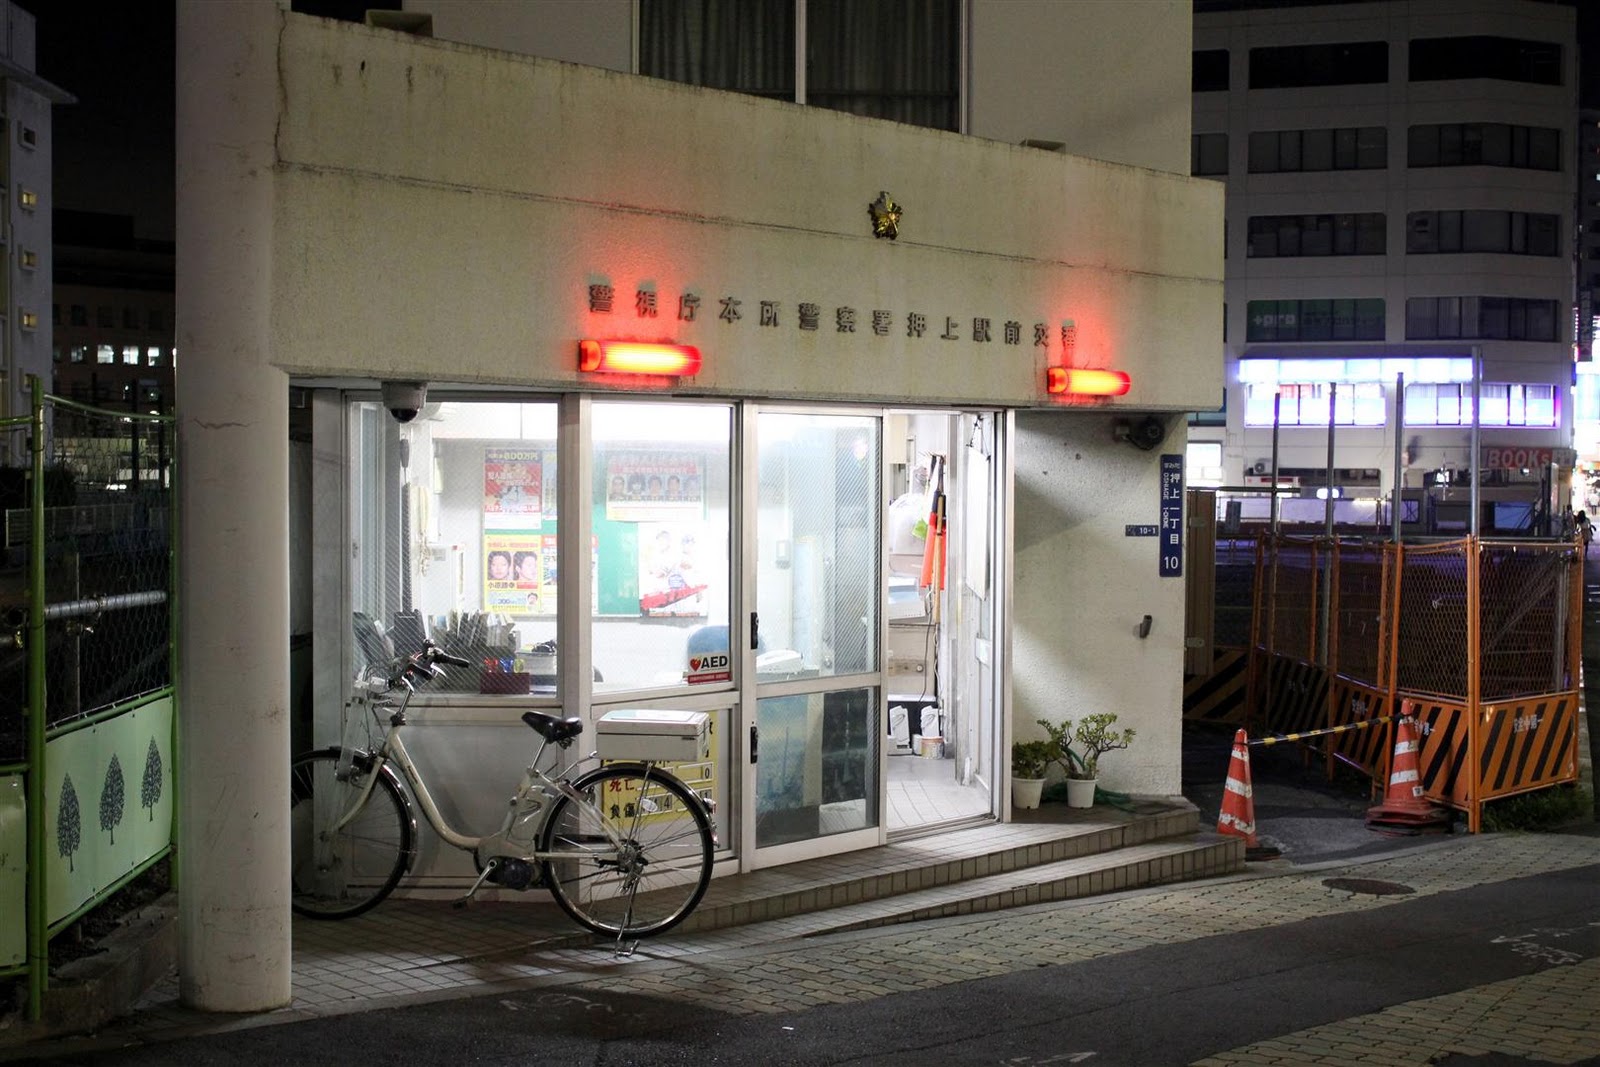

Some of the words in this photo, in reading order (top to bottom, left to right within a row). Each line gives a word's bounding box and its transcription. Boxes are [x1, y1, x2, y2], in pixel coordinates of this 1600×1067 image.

[588, 284, 1077, 348] 警視庁本所警察署押上駅前交番
[1169, 473, 1180, 545] 押上一丁目
[1164, 556, 1179, 569] 10
[702, 656, 728, 668] AED
[704, 767, 711, 779] 0
[609, 779, 634, 793] 死亡
[609, 802, 636, 819] 負傷
